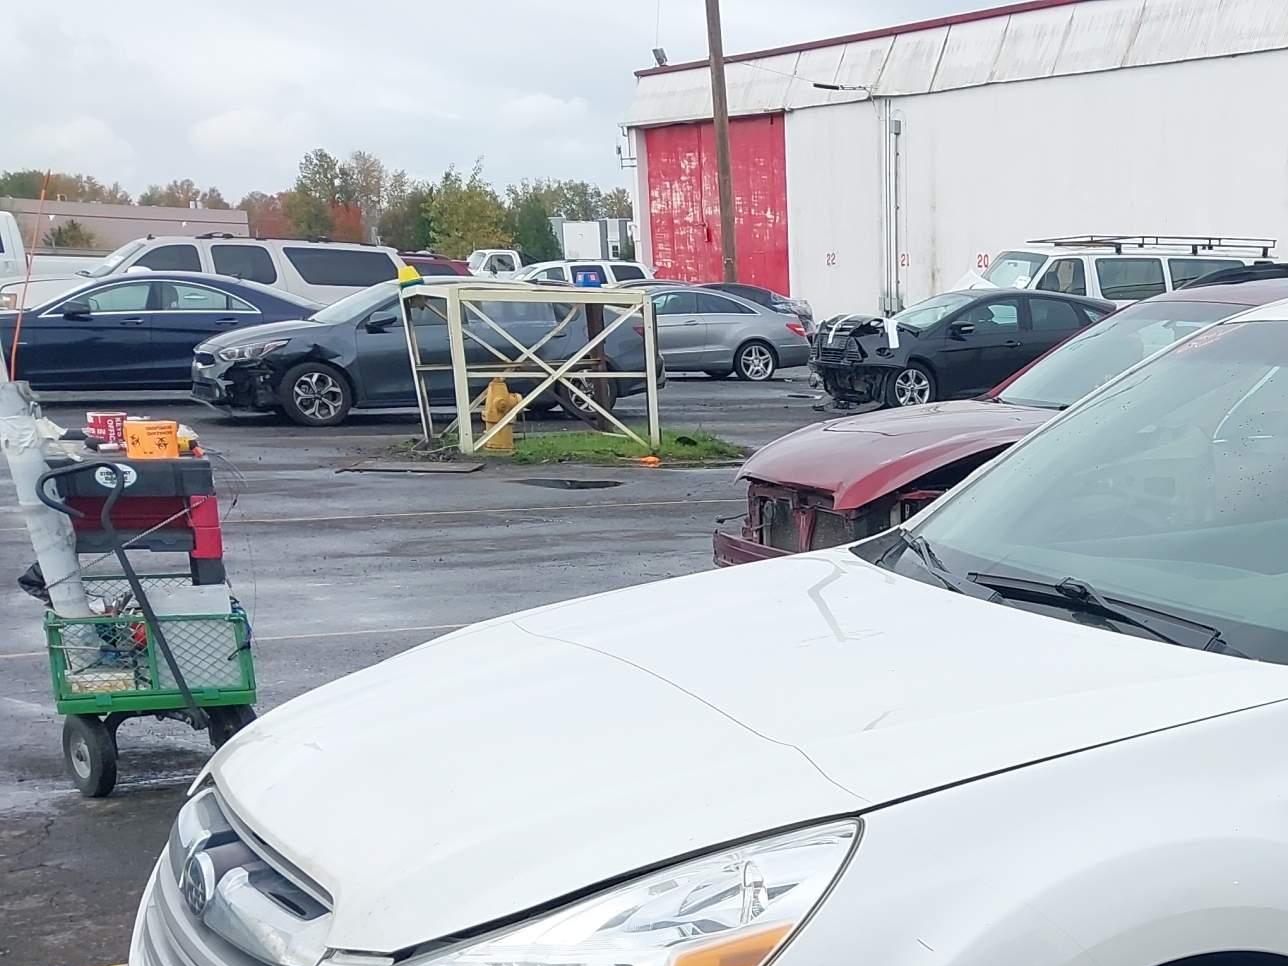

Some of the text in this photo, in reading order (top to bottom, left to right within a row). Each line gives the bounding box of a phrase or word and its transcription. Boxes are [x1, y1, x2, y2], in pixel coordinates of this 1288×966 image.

[826, 253, 836, 266] 22
[901, 253, 910, 267] 21
[977, 253, 990, 268] 20
